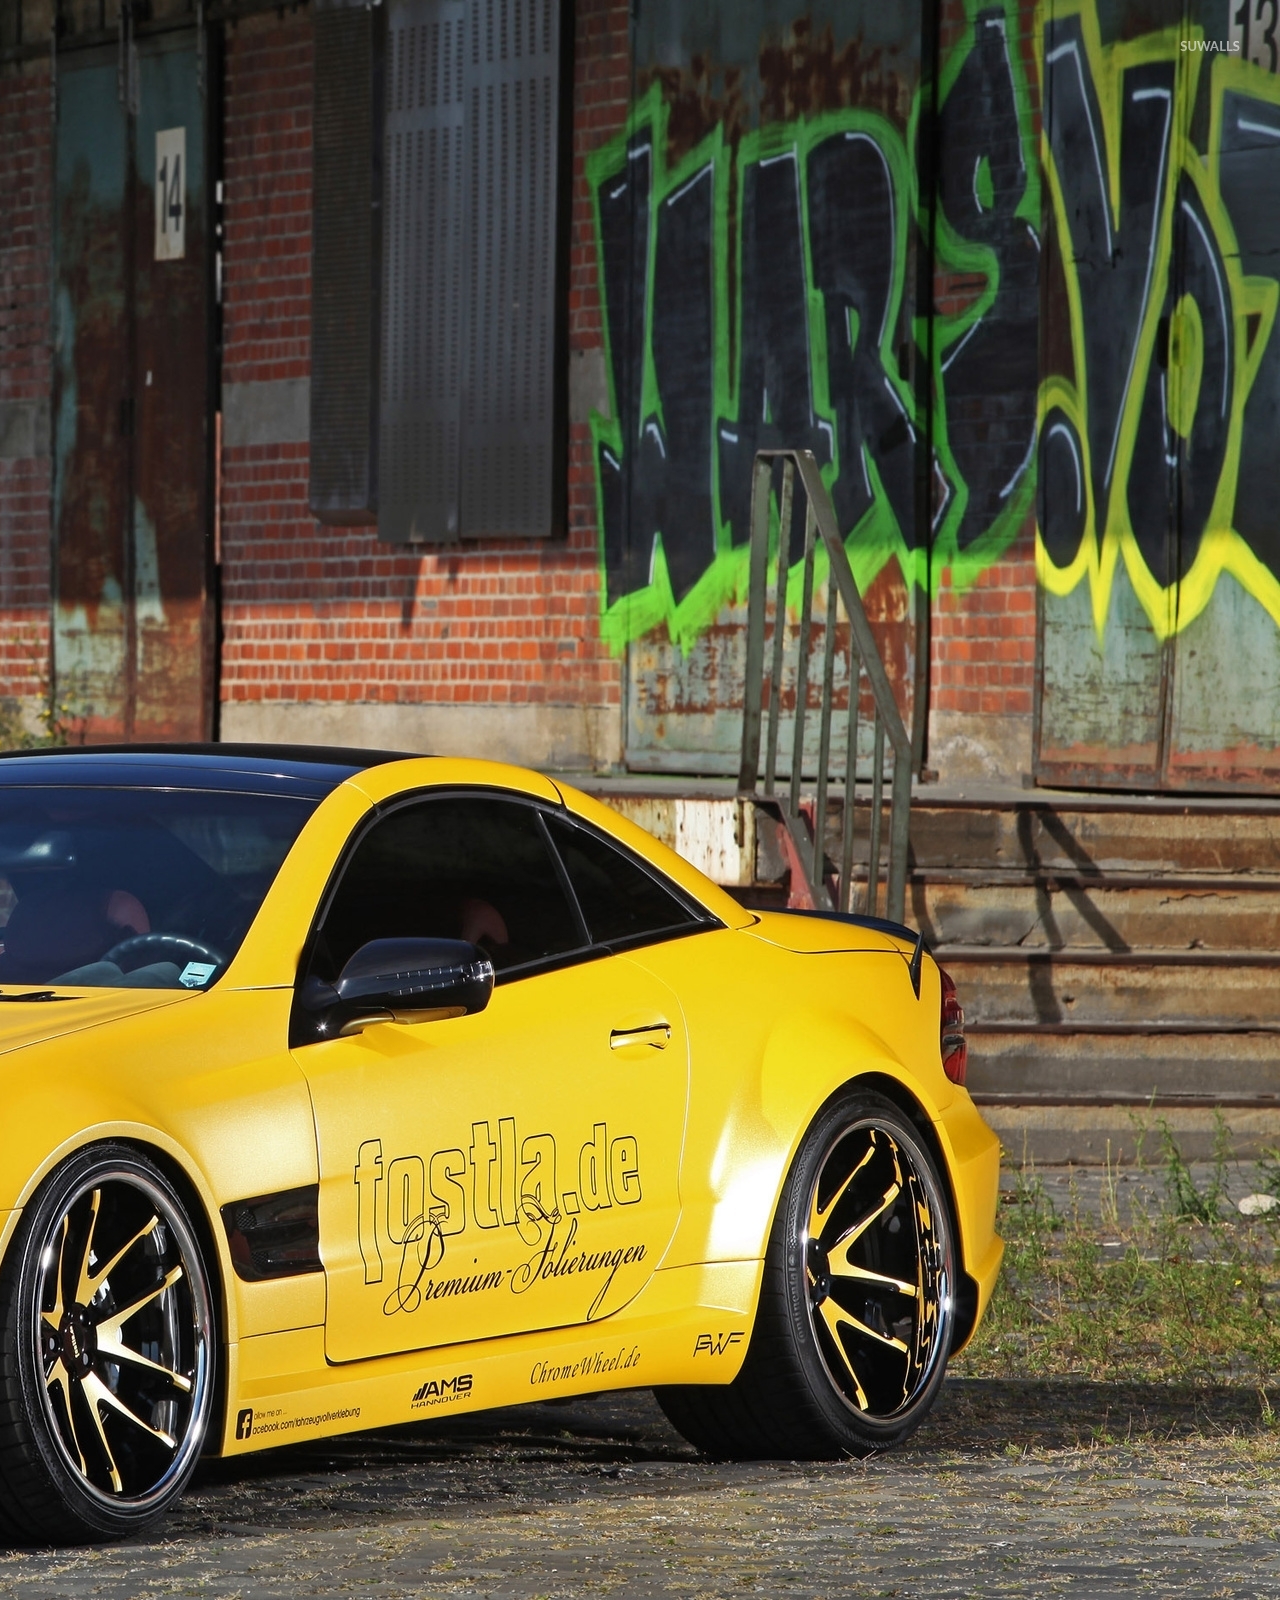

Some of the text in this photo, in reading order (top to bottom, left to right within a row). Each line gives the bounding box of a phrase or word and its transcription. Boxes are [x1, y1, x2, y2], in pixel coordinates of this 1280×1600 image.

[1235, 0, 1279, 73] 13
[158, 153, 182, 234] 14
[353, 1117, 642, 1286] fostla.de
[411, 1392, 471, 1409] HANNOVER
[530, 1345, 641, 1385] ChromeWheel.de
